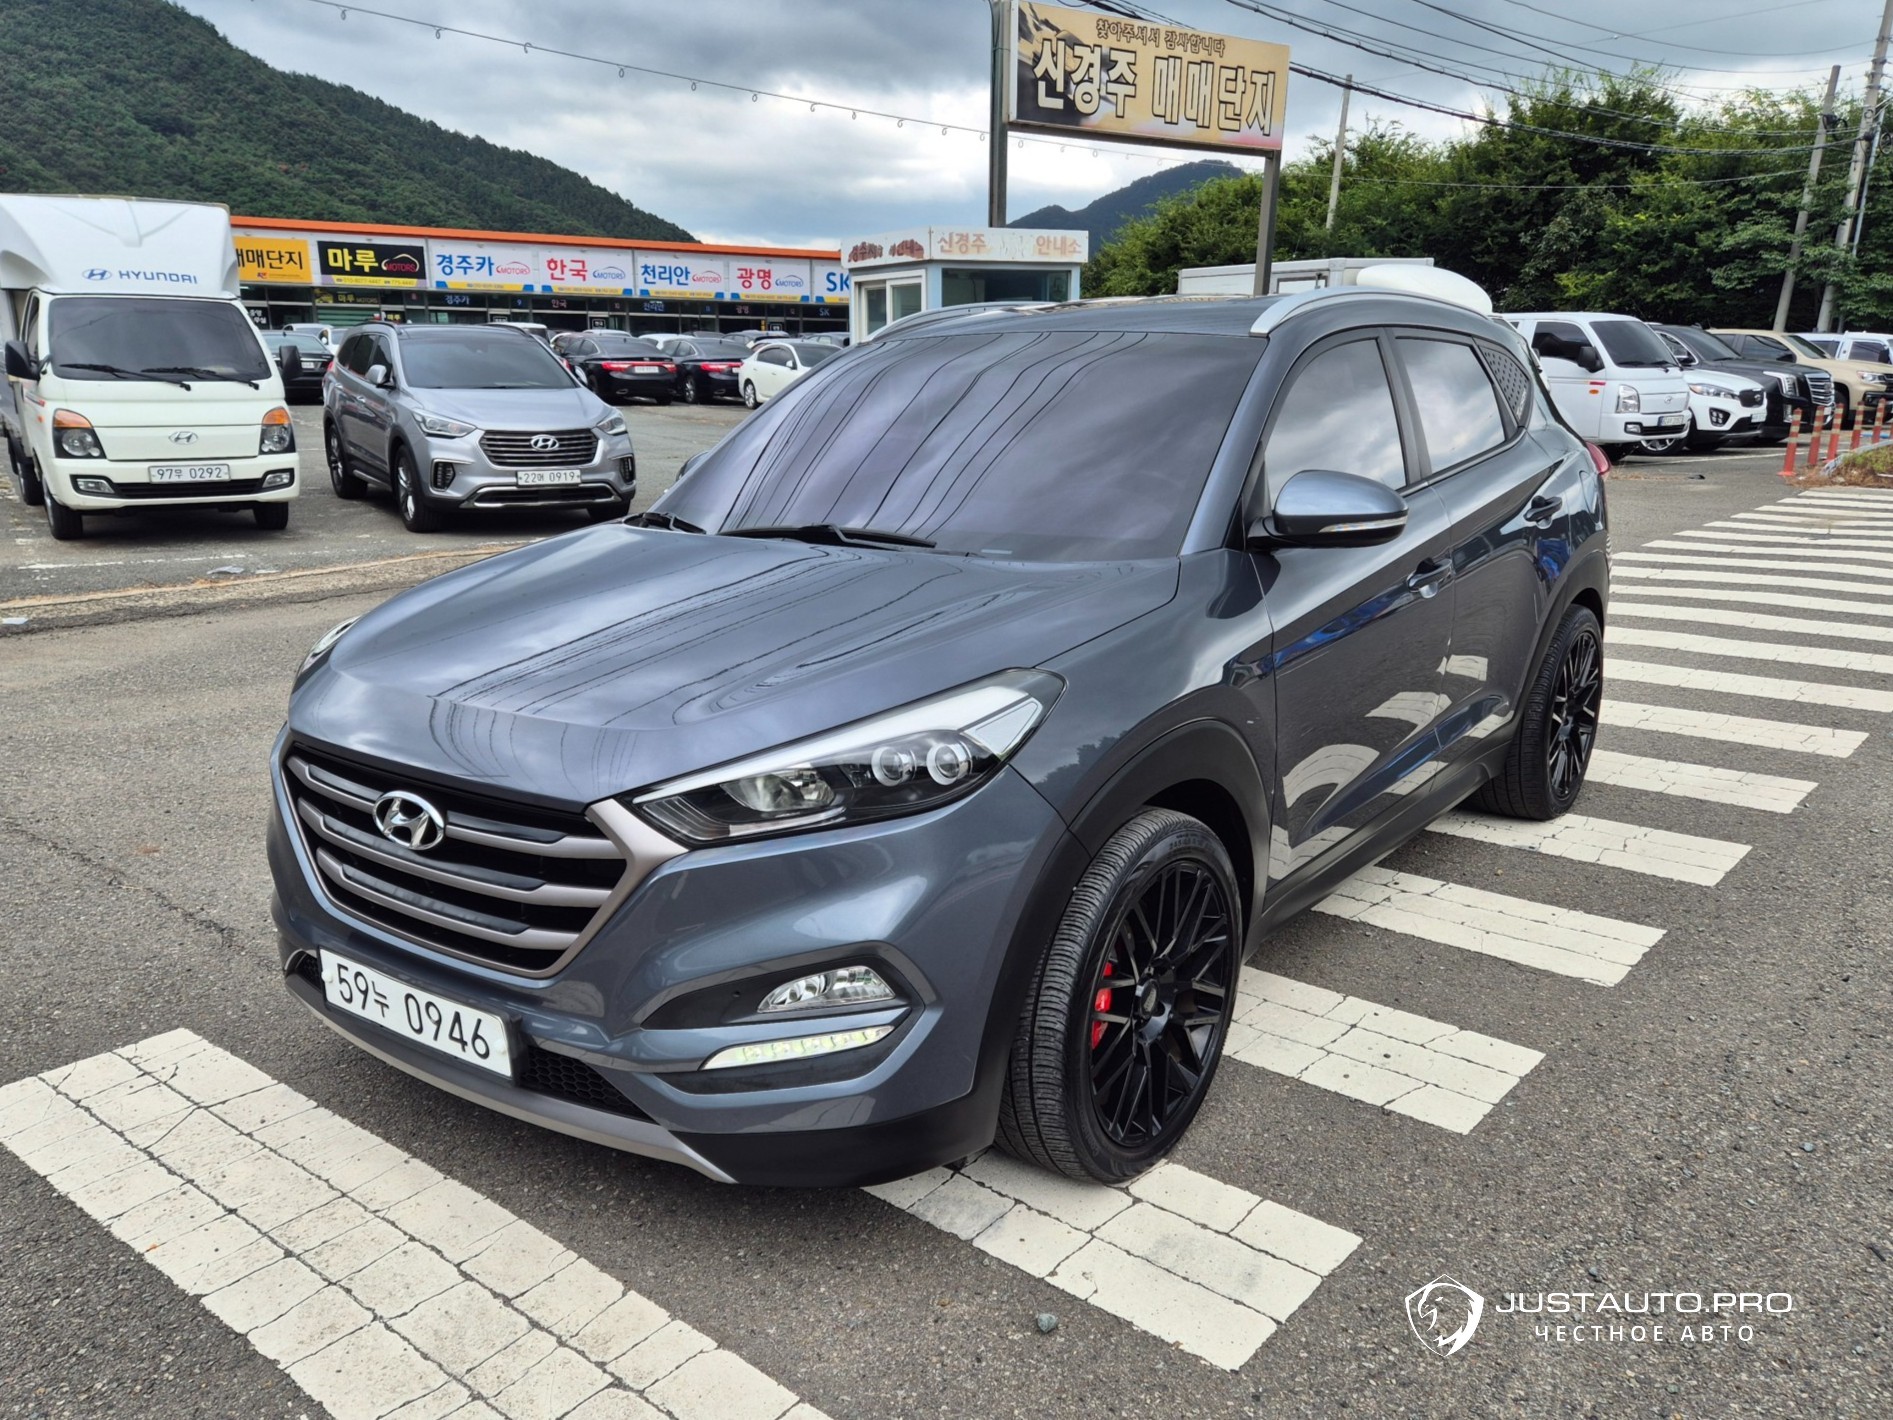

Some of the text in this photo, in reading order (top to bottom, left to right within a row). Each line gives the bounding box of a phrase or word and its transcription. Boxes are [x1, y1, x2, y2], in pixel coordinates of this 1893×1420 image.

[1096, 18, 1226, 58] 찾아주셔서 감사합니다
[1033, 38, 1276, 136] 신경주 매매단지
[937, 232, 1083, 256] 신경주 안내소
[327, 248, 416, 272] 마루 MOTORS
[436, 254, 528, 277] 경주카 MOTORS
[546, 258, 587, 281] 한국
[118, 270, 198, 284] HYUNDAI
[640, 264, 720, 286] 천리안 MOTORS
[737, 268, 801, 290] 광명 MOTORS
[826, 272, 849, 292] SK
[156, 467, 222, 480] 97무 0292
[549, 471, 575, 482] 0919
[337, 963, 491, 1060] 59누 0946
